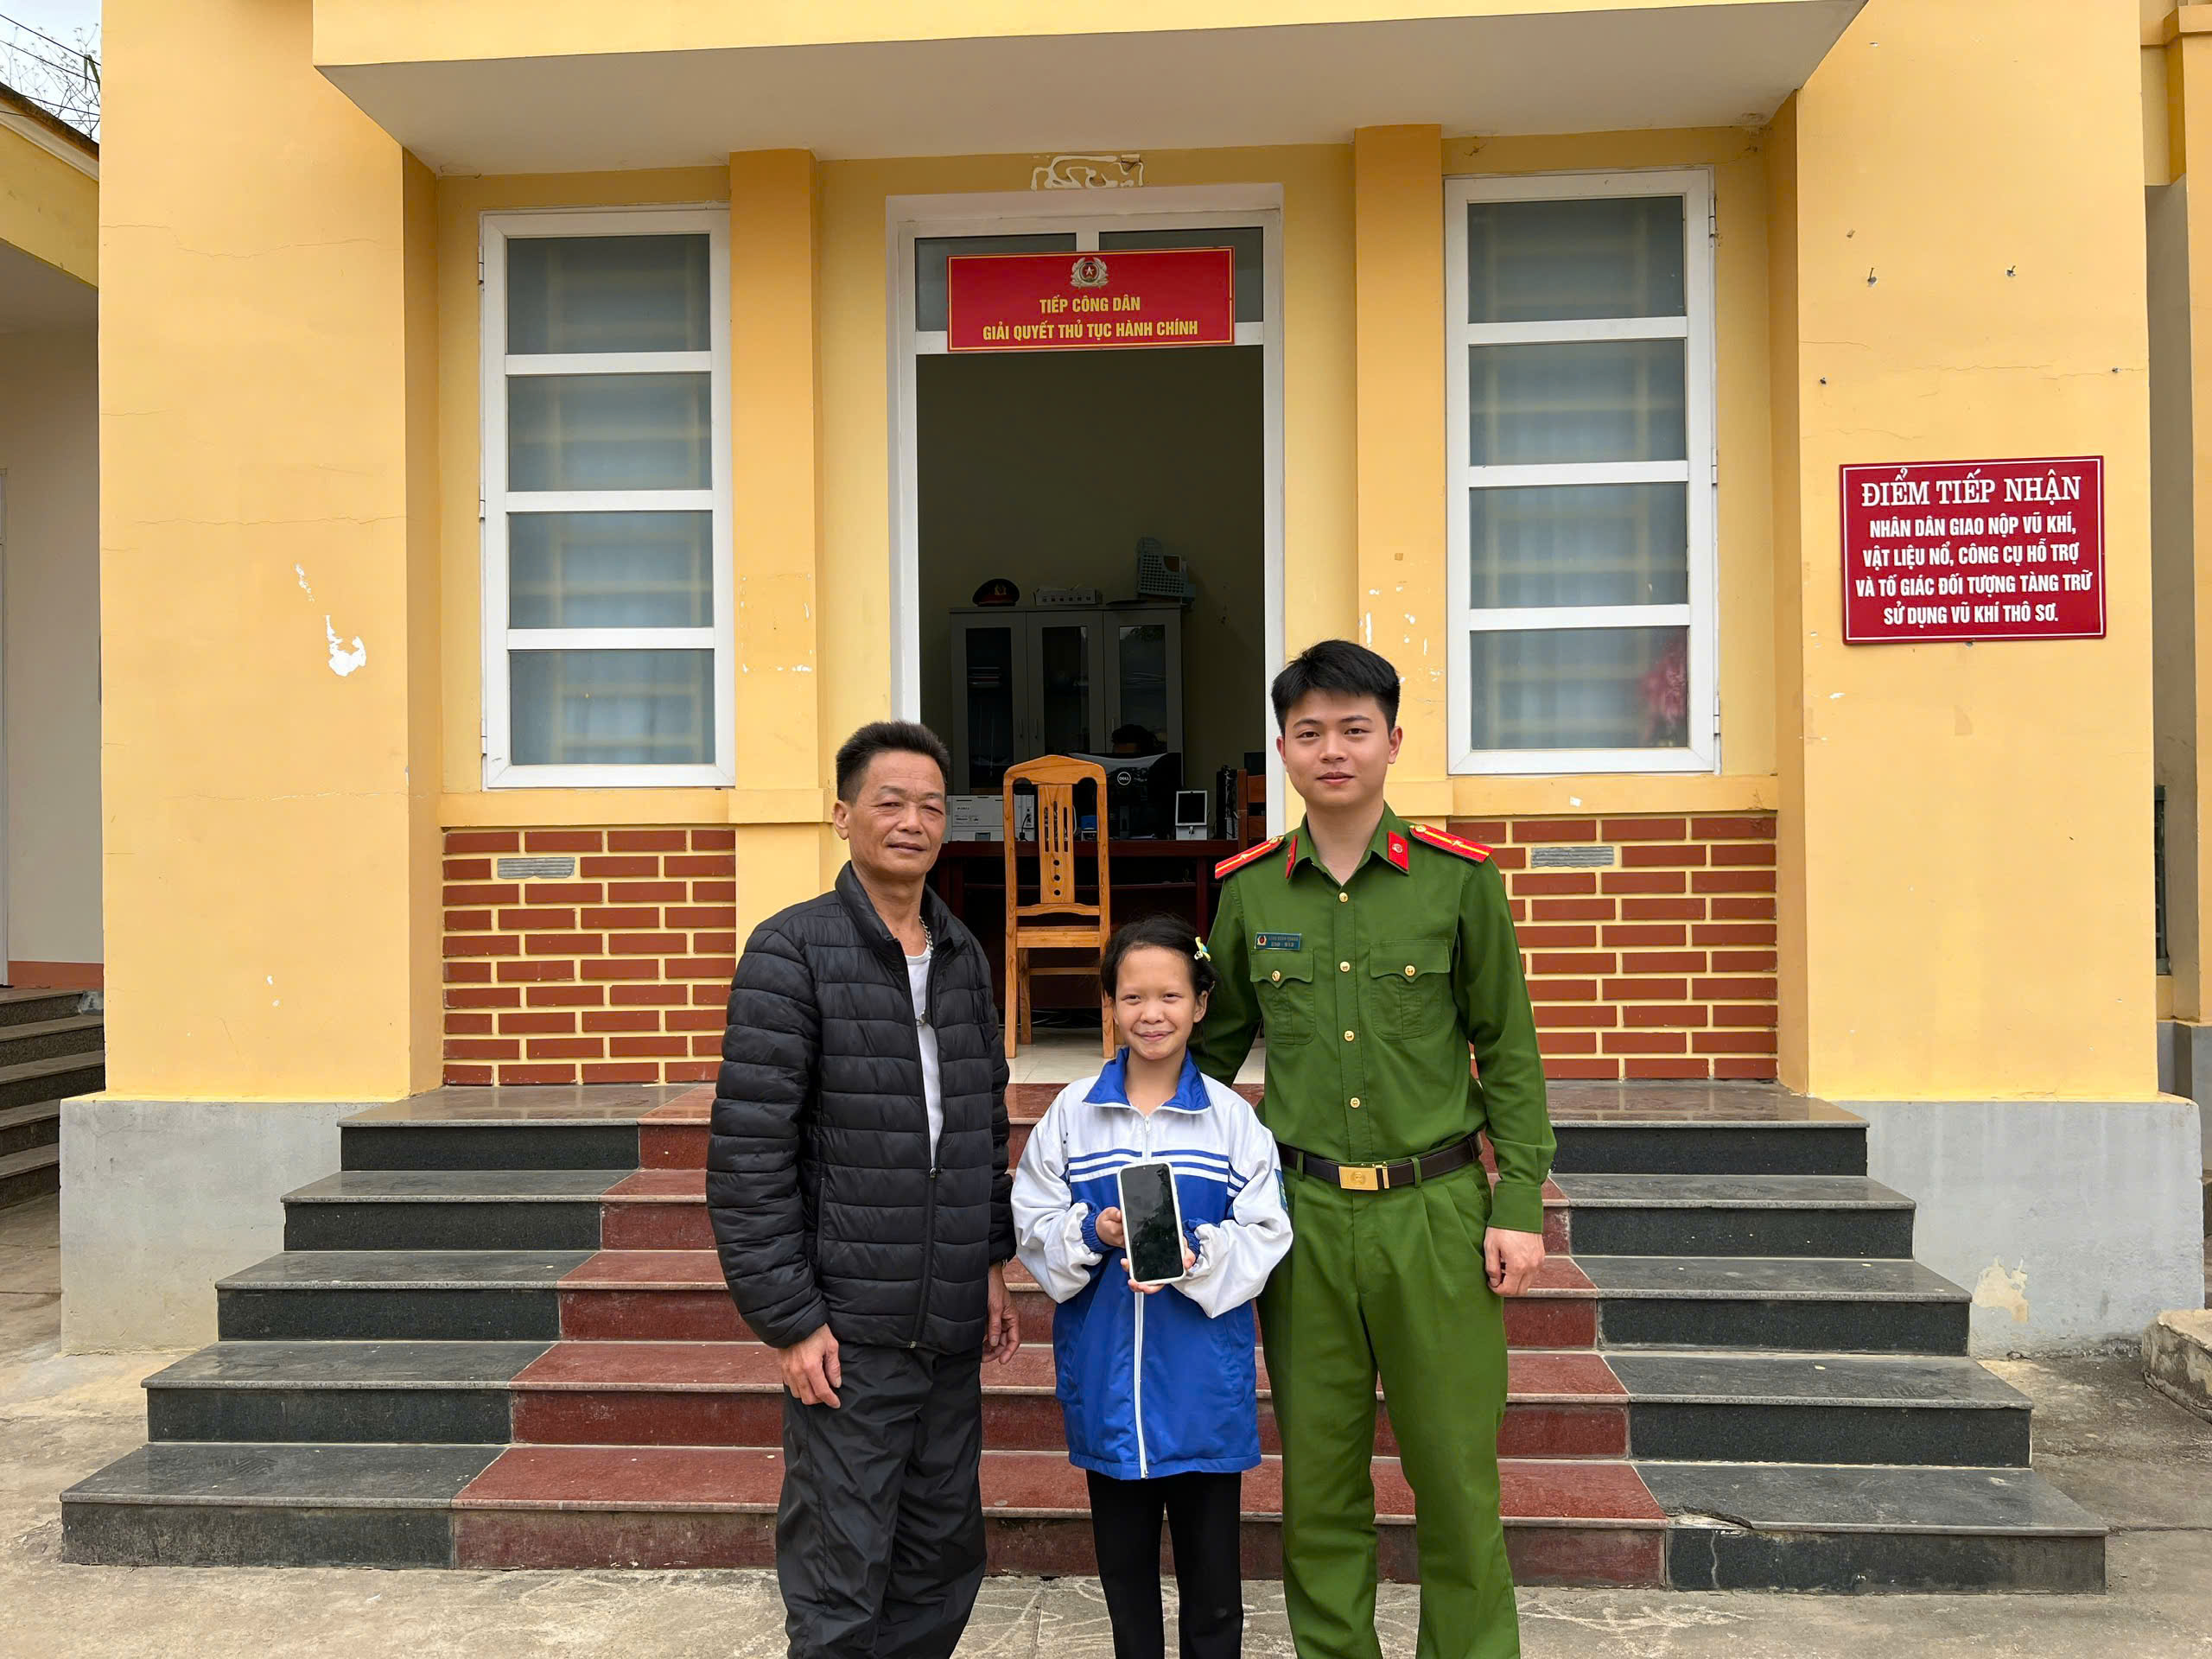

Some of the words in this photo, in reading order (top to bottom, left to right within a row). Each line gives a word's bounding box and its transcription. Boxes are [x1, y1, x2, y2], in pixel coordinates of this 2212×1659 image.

[1039, 295, 1069, 314] TIẾP
[1072, 295, 1109, 313] CÔNG
[1112, 294, 1141, 311] DÂN
[982, 321, 1009, 340] GIẢI
[1013, 320, 1054, 341] QUYẾT
[1058, 319, 1084, 339] THỦ
[1086, 323, 1112, 340] TỤC
[1116, 319, 1153, 337] HÀNH
[1156, 318, 1198, 336] CHÍNH
[1861, 467, 1930, 507] ĐIỂM
[1936, 468, 1996, 505] TIẾP
[2003, 468, 2082, 505] NHẬN
[1870, 516, 1911, 538] NHÂN
[1914, 515, 1946, 537] DÂN
[1949, 517, 1984, 536] GIAO
[1988, 512, 2019, 538] NỘP
[2022, 512, 2042, 534] VŨ
[2046, 511, 2076, 535] KHÍ,
[1862, 544, 1891, 571] VẬT
[1893, 544, 1925, 570] LIỆU
[1929, 541, 1955, 567] NỔ,
[1958, 543, 1999, 565] CÔNG
[2002, 545, 2023, 566] CỤ
[2026, 537, 2047, 563] HỖ
[2050, 542, 2080, 565] TRỢ
[1855, 575, 1876, 597] VÀ
[1878, 574, 1897, 597] TỐ
[1900, 574, 1935, 596] GIÁC
[1937, 572, 1963, 595] ĐỐI
[1967, 574, 2016, 598] TƯỢNG
[2019, 570, 2059, 592] TÀNG
[2062, 569, 2093, 591] TRỮ
[1884, 601, 1905, 626] SỬ
[1907, 607, 1948, 628] DỤNG
[1950, 601, 1970, 624] VŨ
[1974, 601, 1999, 623] KHÍ
[2002, 601, 2031, 623] THÔ
[2035, 602, 2059, 622] SƠ.
